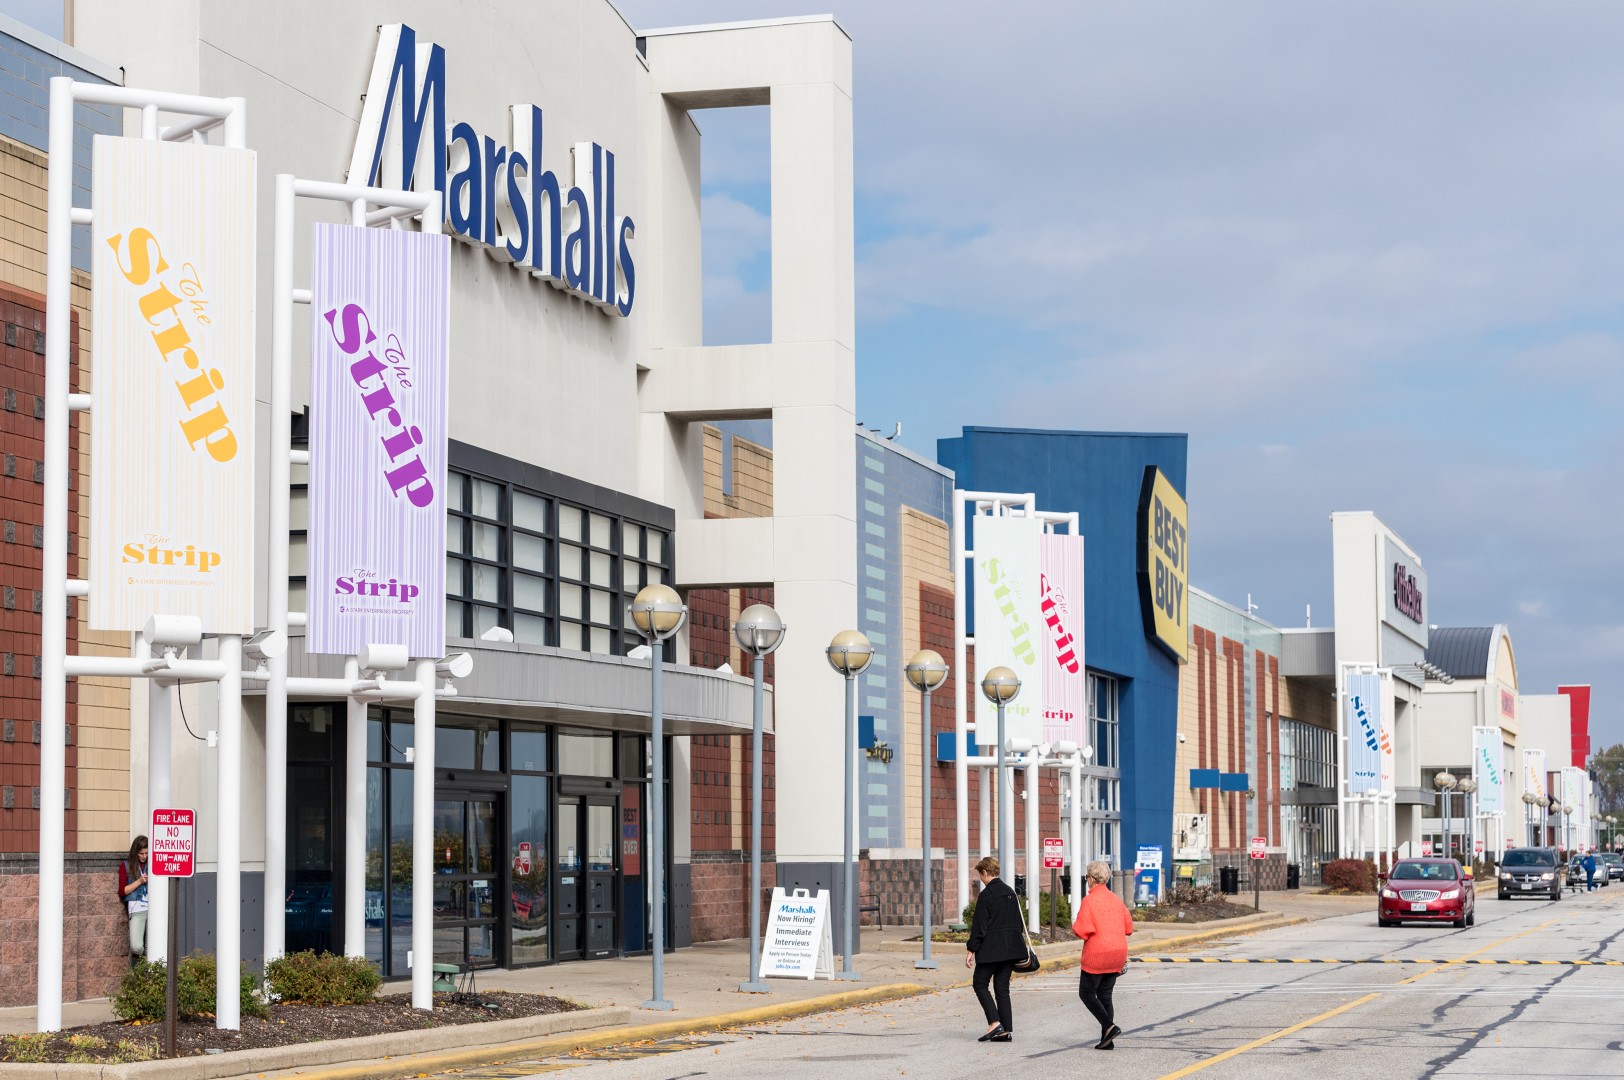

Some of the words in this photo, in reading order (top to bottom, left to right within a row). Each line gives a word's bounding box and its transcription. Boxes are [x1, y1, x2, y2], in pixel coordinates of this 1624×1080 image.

[358, 23, 636, 317] Marshalls
[179, 262, 211, 326] The
[106, 227, 238, 462] Strip
[385, 333, 412, 389] The
[323, 303, 434, 508] Strip
[144, 533, 170, 544] The
[1155, 493, 1186, 574] BEST
[122, 543, 221, 572] Strip
[354, 568, 376, 578] The
[335, 576, 419, 602] Strip
[1155, 554, 1183, 628] BUY
[981, 557, 1036, 666] Strip
[990, 703, 1030, 717] Srip
[1042, 710, 1073, 721] trip
[1351, 695, 1378, 751] Strip
[1355, 771, 1376, 780] Strip
[156, 814, 171, 823] FIRE
[173, 815, 190, 823] LANE
[624, 808, 638, 822] BEST
[166, 826, 179, 837] NO
[154, 840, 191, 850] PARKING
[624, 840, 638, 855] EVER
[155, 853, 190, 862] TOW-AWAY
[164, 863, 181, 871] ZONE
[365, 899, 385, 919] shalls
[778, 904, 816, 914] Marshalls
[792, 915, 816, 924] Hiring!
[776, 928, 812, 936] Immediate
[775, 938, 810, 947] Interviews
